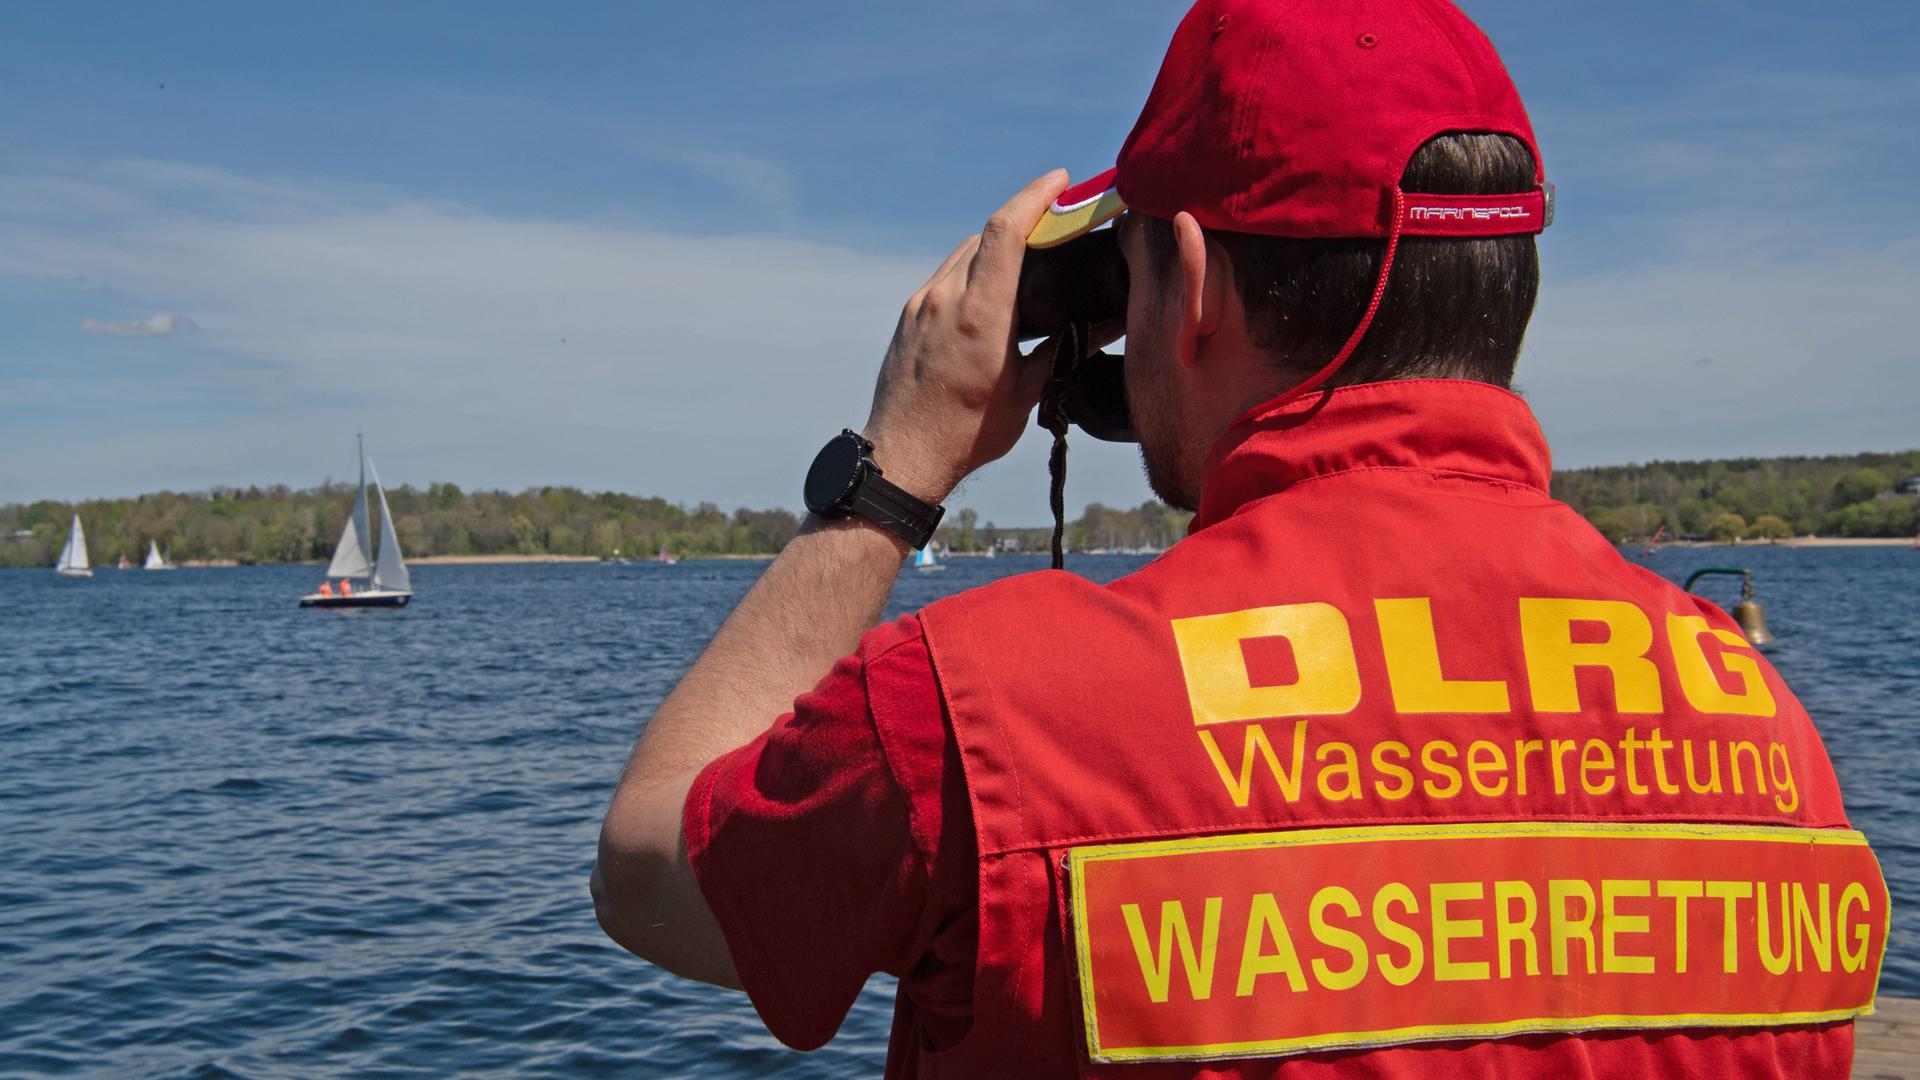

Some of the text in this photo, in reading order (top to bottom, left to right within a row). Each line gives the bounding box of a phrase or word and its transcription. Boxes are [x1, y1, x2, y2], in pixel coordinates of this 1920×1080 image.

[1410, 206, 1530, 219] MARINEPOOL
[1171, 597, 1777, 726] DLRG
[1198, 720, 1799, 814] Wasserrettung
[1121, 879, 1871, 1003] WASSERRETTUNG
